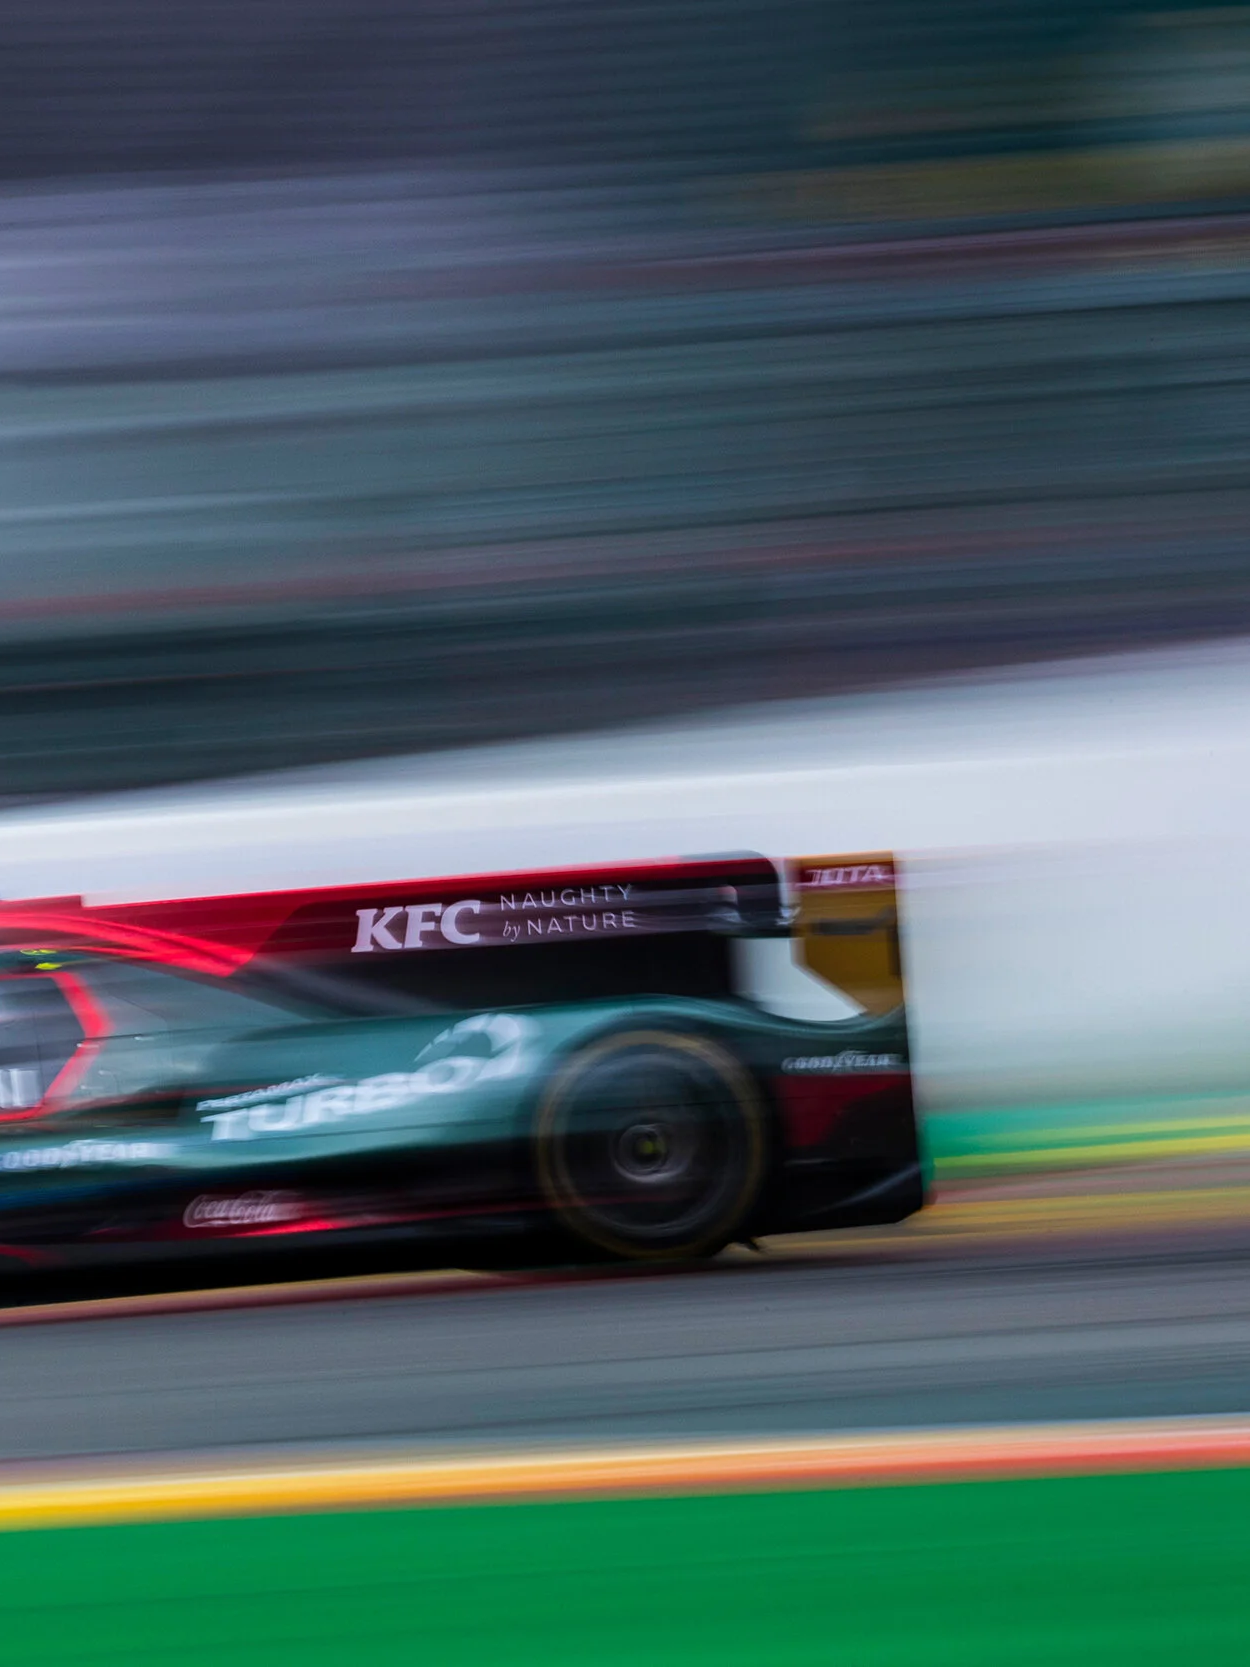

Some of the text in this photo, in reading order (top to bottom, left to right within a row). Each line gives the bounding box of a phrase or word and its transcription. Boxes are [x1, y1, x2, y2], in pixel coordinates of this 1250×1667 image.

[501, 884, 633, 911] NAUGHTY
[351, 900, 480, 953] KFC
[503, 911, 636, 942] by NATURE
[201, 1056, 488, 1141] TURBO
